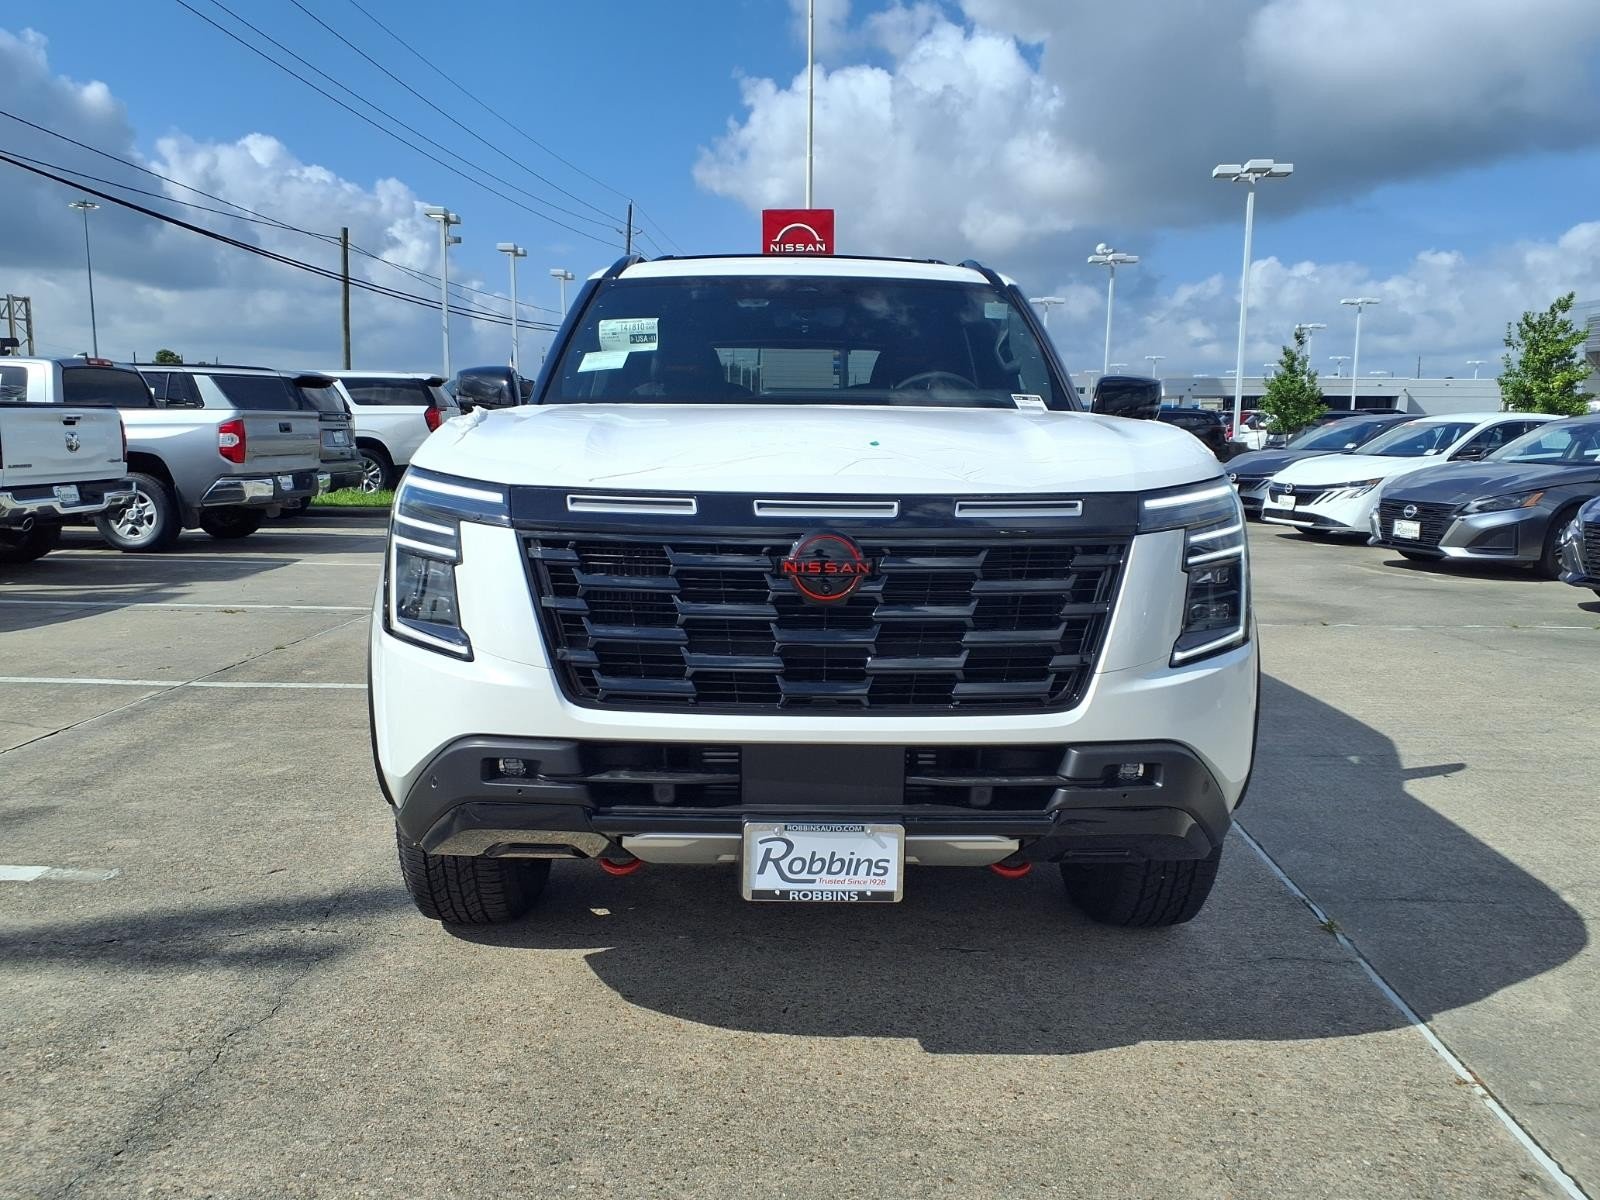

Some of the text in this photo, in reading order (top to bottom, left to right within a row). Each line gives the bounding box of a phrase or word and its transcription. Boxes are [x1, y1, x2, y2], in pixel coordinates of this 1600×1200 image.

[770, 244, 826, 252] NISSAN
[784, 562, 870, 573] NISSAN
[757, 837, 890, 884] Robbins
[789, 890, 859, 901] ROBBINS
